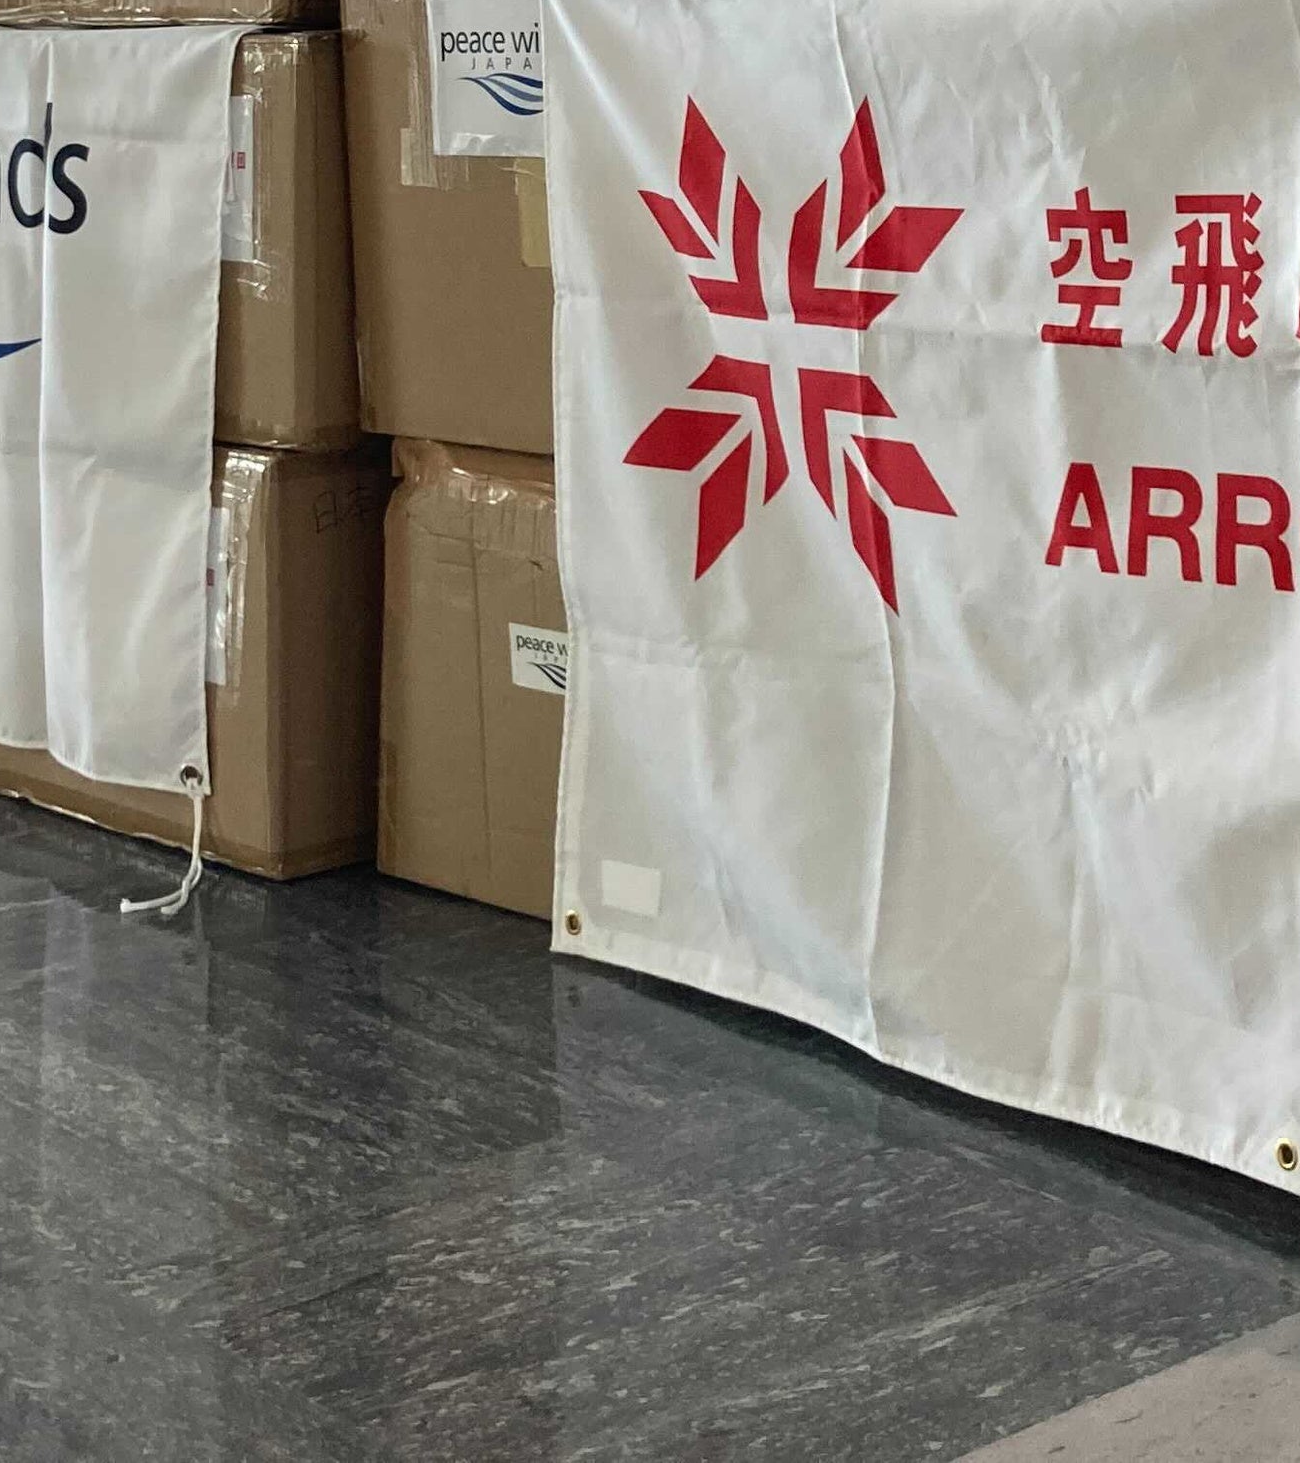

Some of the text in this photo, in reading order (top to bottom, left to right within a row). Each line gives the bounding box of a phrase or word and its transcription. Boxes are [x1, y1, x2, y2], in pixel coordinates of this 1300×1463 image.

[440, 30, 506, 62] peace
[471, 56, 533, 71] JAPA
[516, 634, 555, 654] peace
